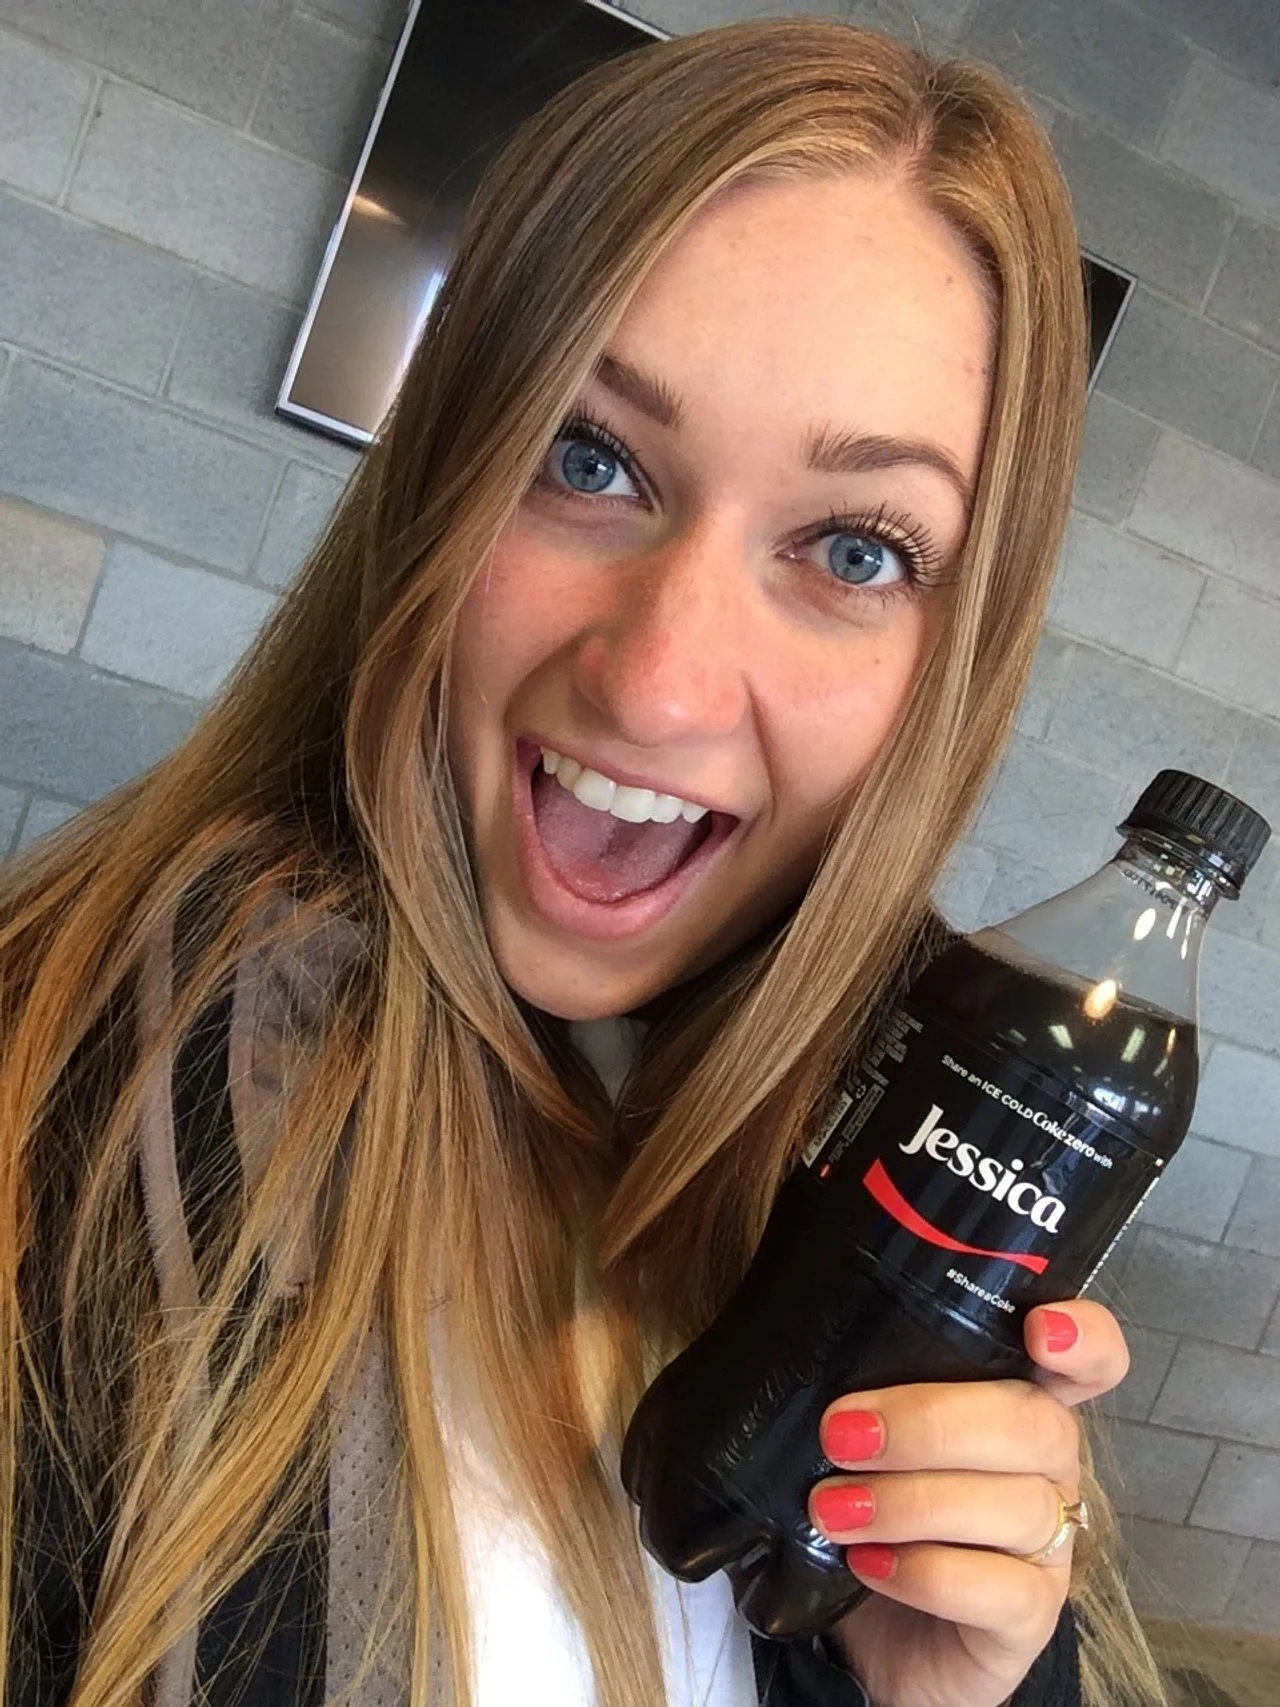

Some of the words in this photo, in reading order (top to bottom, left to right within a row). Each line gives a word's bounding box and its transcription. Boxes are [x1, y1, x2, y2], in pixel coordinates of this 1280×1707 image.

[899, 1103, 1067, 1234] Jessica
[941, 1054, 968, 1078] Share
[967, 1073, 982, 1087] an
[981, 1080, 1003, 1100] ICE
[1001, 1094, 1034, 1119] COLD
[1033, 1111, 1066, 1141] Coke
[1065, 1132, 1095, 1158] zero
[1093, 1153, 1114, 1170] with
[946, 1268, 1017, 1314] #ShareaCoke
